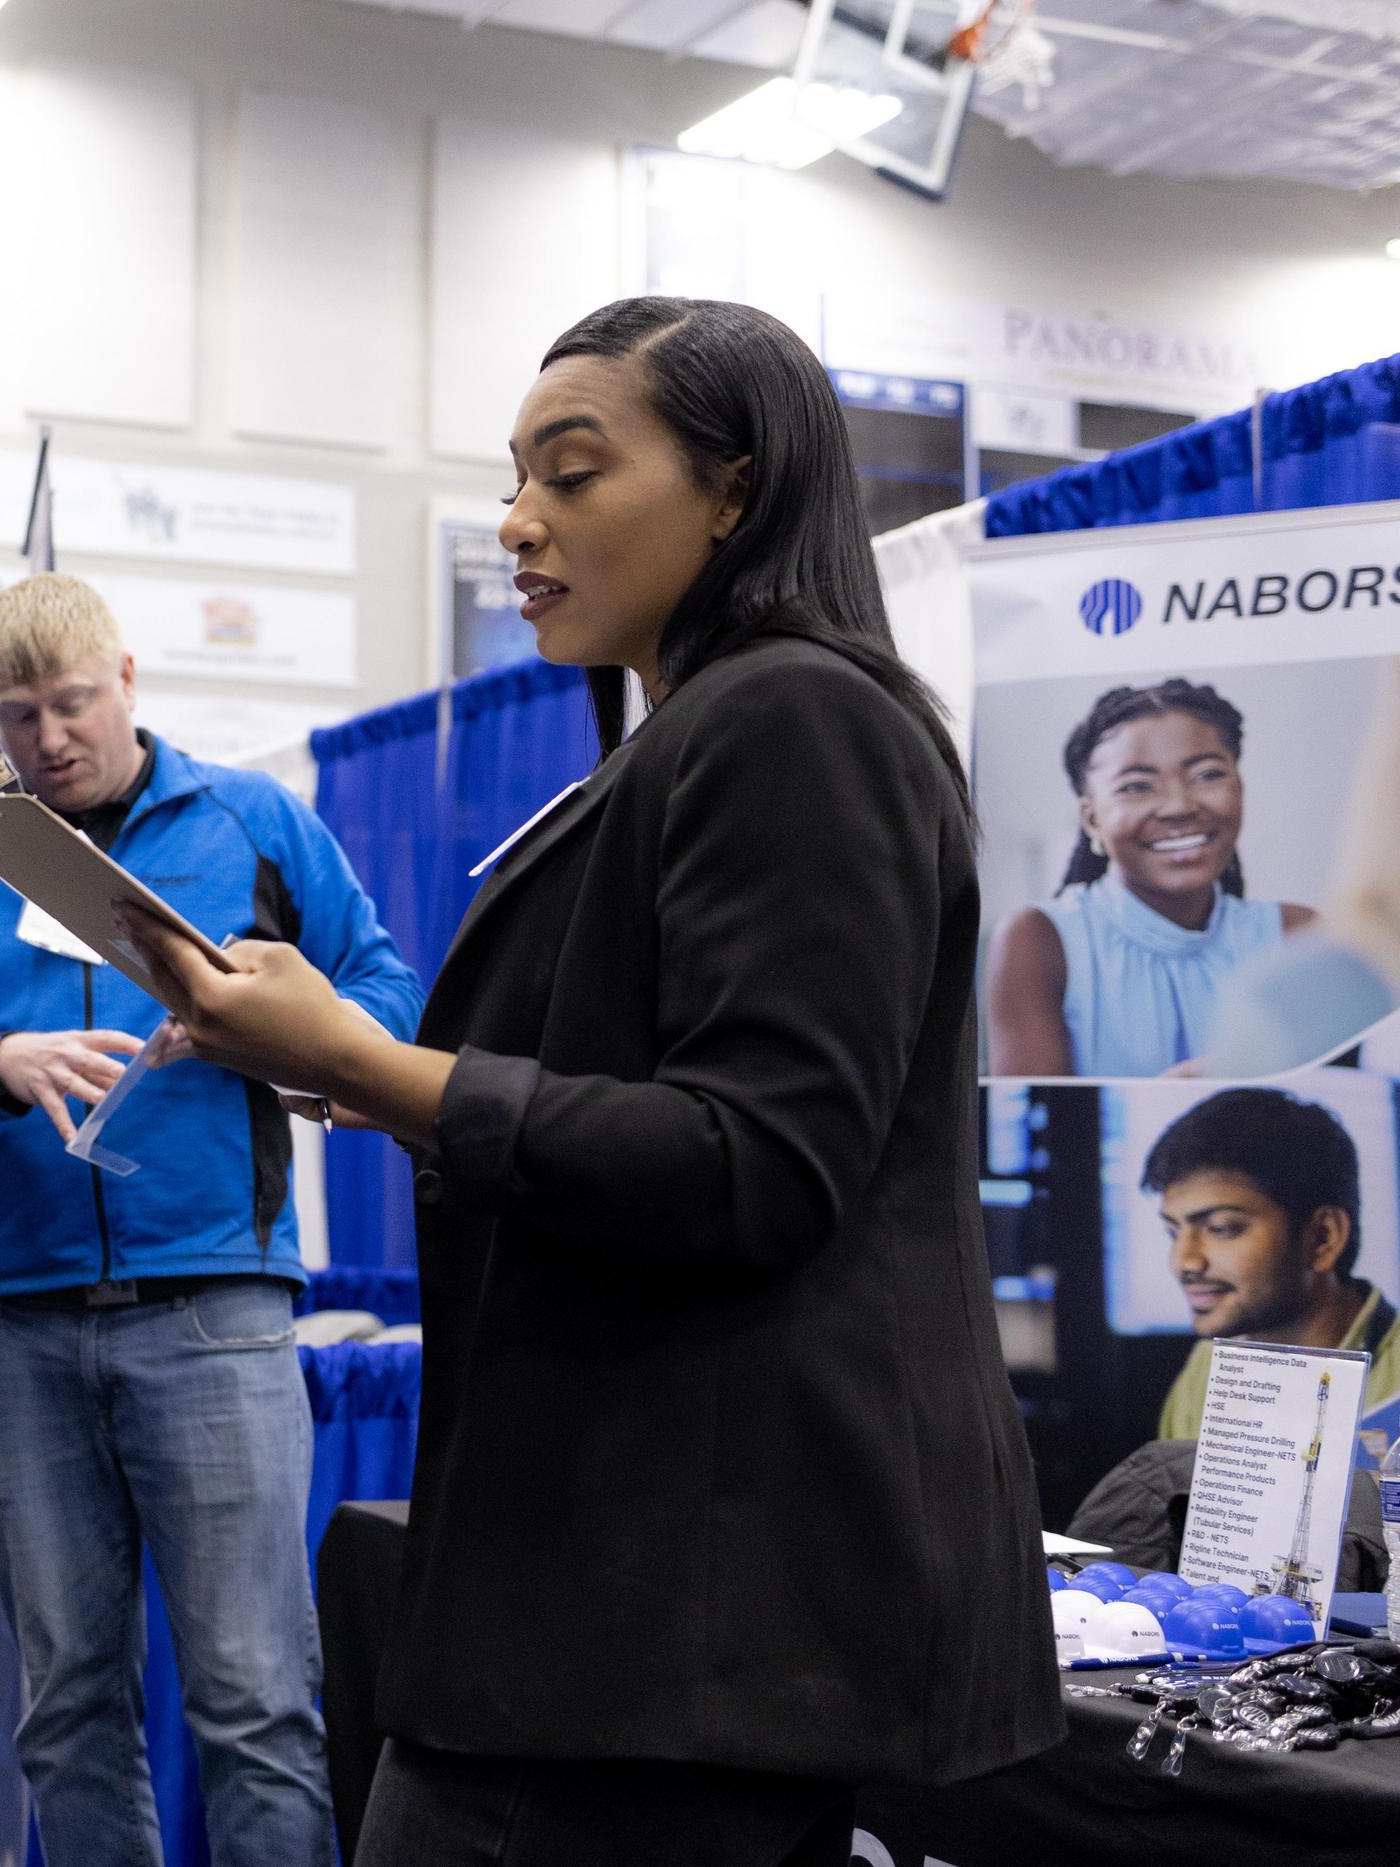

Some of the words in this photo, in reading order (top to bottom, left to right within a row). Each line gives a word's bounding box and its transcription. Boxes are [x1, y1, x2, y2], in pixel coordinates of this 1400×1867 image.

[1162, 566, 1400, 624] NABOR
[1219, 1350, 1249, 1361] Business
[1250, 1354, 1290, 1366] Intelligence
[1290, 1358, 1307, 1368] Data
[1219, 1363, 1244, 1375] Analyst
[1215, 1376, 1238, 1387] Design
[1240, 1379, 1252, 1388] and
[1253, 1380, 1281, 1393] Drafting
[1213, 1389, 1228, 1399] Help
[1229, 1390, 1246, 1400] Desk
[1248, 1393, 1276, 1404] Support
[1211, 1402, 1225, 1411] HSE
[1209, 1414, 1252, 1428] International
[1253, 1420, 1263, 1429] HR
[1208, 1427, 1239, 1440] Managed
[1240, 1431, 1270, 1443] Pressure
[1271, 1436, 1296, 1449] Drilling
[1206, 1440, 1244, 1452] Mechanical
[1245, 1444, 1296, 1461] Engineer-NETS
[1203, 1453, 1240, 1466] Operations
[1241, 1459, 1267, 1471] Analyst
[1201, 1465, 1245, 1479] Performance
[1245, 1473, 1276, 1485] Products
[1199, 1478, 1236, 1492] Operations
[1237, 1485, 1263, 1496] Finance
[1197, 1491, 1217, 1502] QHSE
[1217, 1495, 1243, 1506] Advisor
[1195, 1504, 1227, 1517] Reliability
[1228, 1510, 1258, 1522] Engineer
[1193, 1516, 1221, 1529] (Tubular
[1222, 1522, 1254, 1536] Services)
[1191, 1530, 1205, 1539] R&D
[1211, 1534, 1229, 1544] NETS
[1189, 1542, 1211, 1554] Rigline
[1213, 1547, 1249, 1562] Technician
[1185, 1568, 1206, 1581] Talent
[1207, 1575, 1220, 1584] and
[1187, 1555, 1217, 1569] Software
[1217, 1562, 1269, 1581] Engineer-NETS
